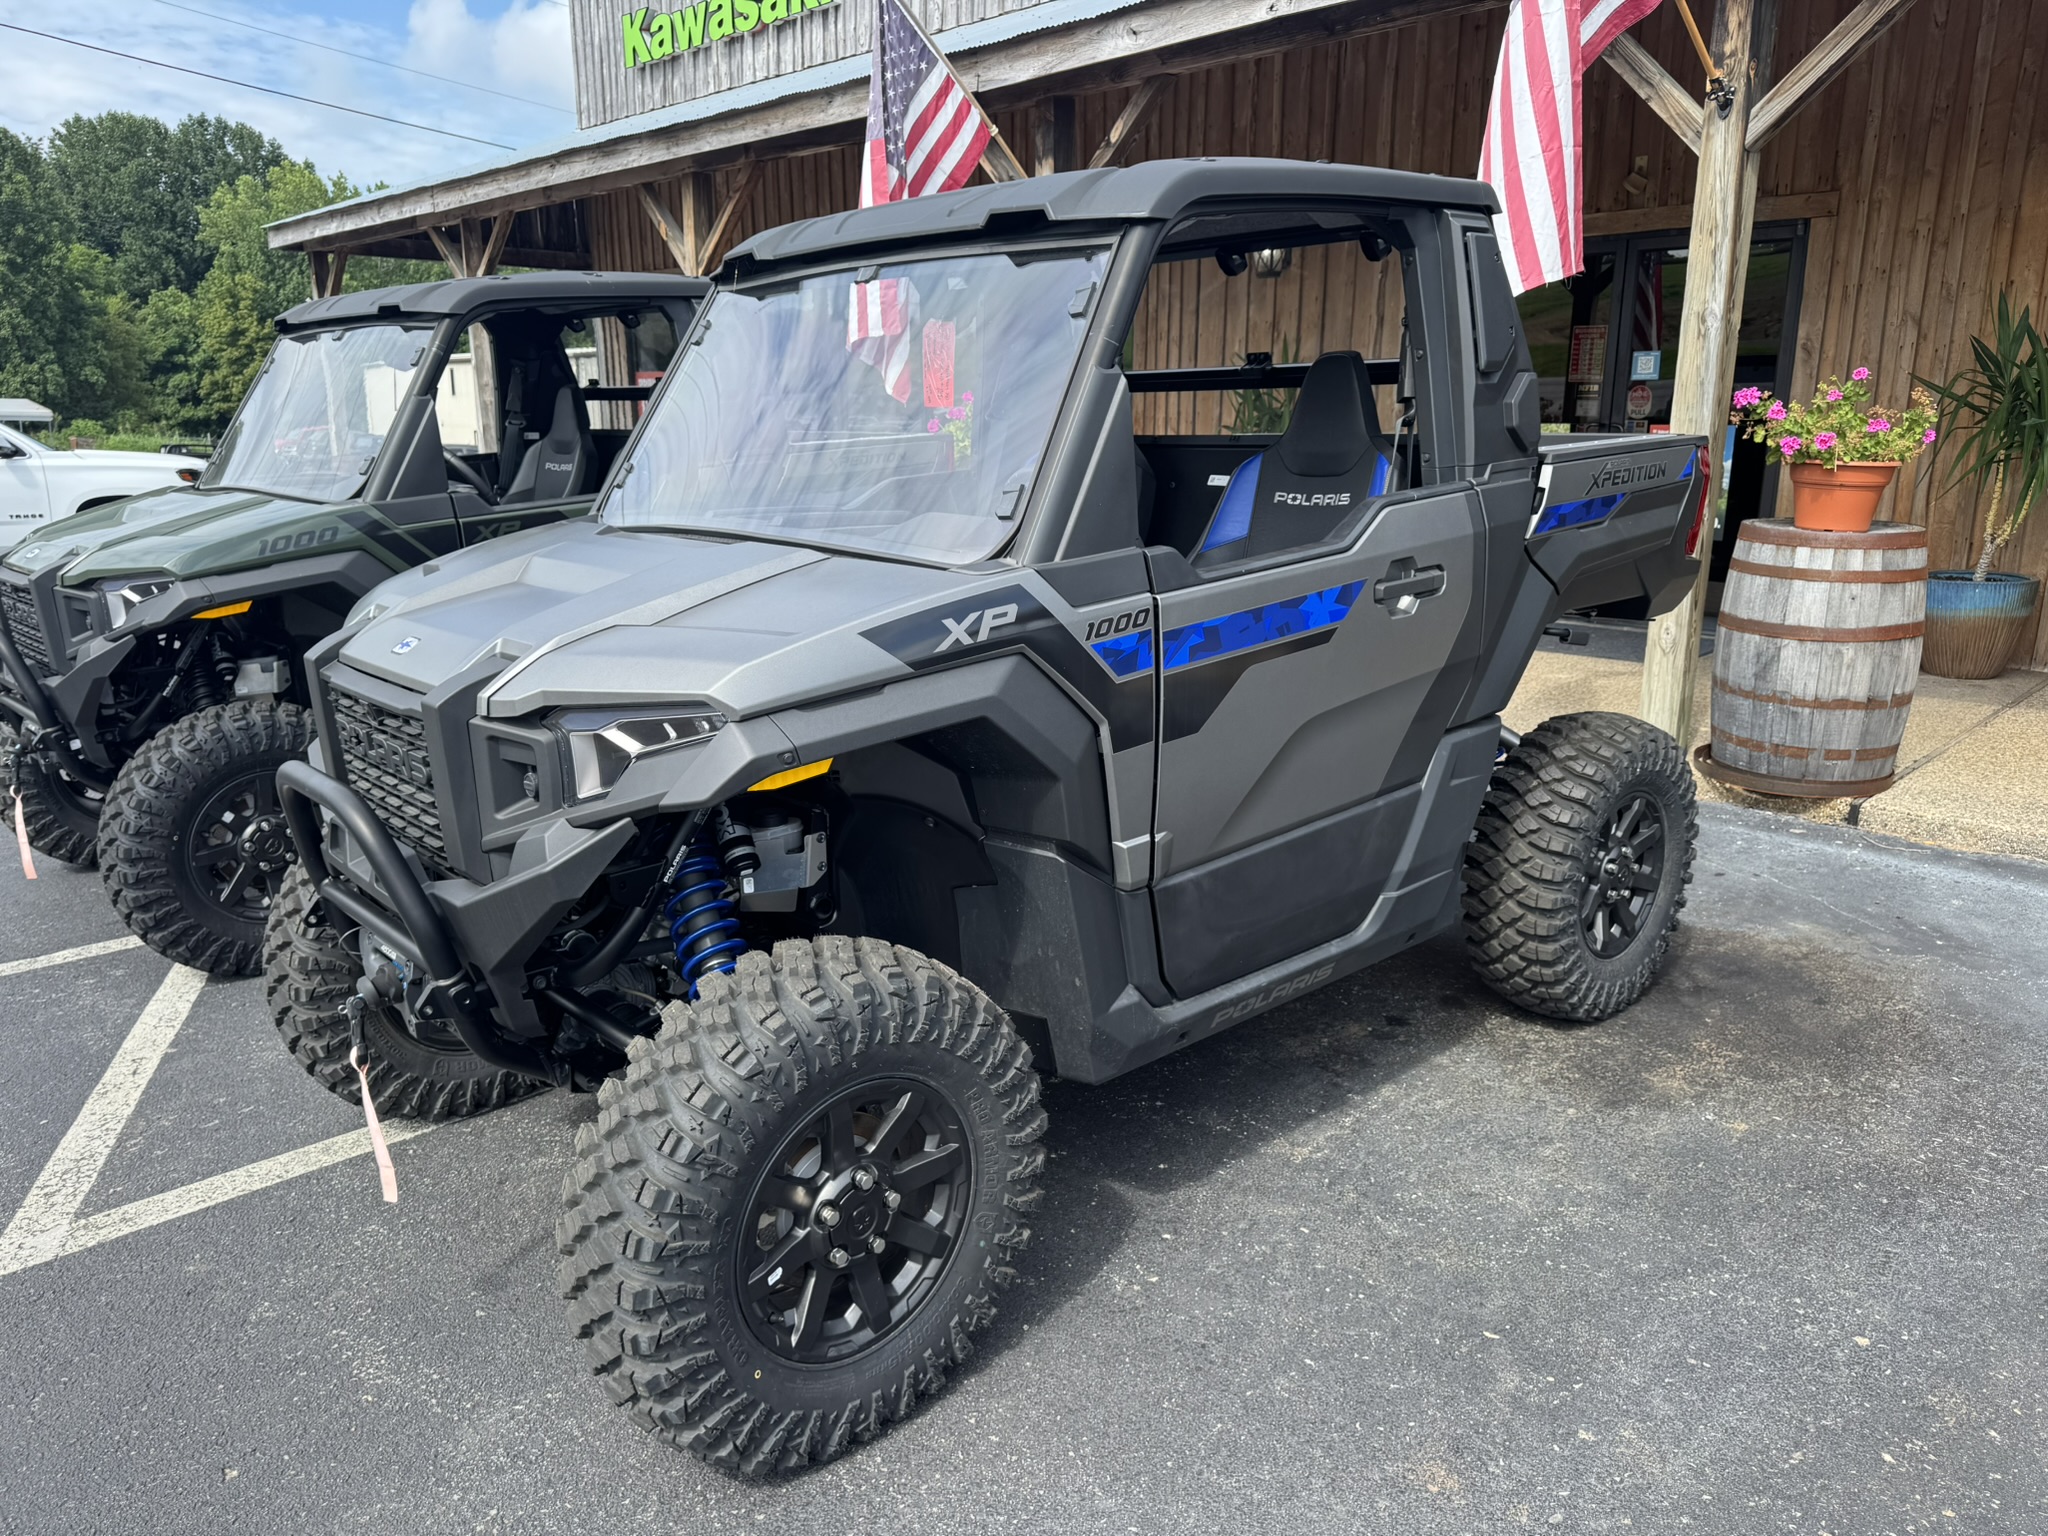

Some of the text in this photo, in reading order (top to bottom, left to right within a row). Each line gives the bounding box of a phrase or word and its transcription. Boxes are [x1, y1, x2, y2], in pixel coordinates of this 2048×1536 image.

[621, 0, 834, 69] Kawasa
[545, 462, 573, 472] POLARIS
[1584, 461, 1668, 496] XPEDITION
[1273, 491, 1351, 507] POLARIS
[258, 526, 340, 557] 1000
[933, 602, 1019, 653] XP
[1084, 607, 1151, 642] 1000
[663, 844, 688, 884] POLARIS
[1209, 961, 1337, 1029] POLARIS
